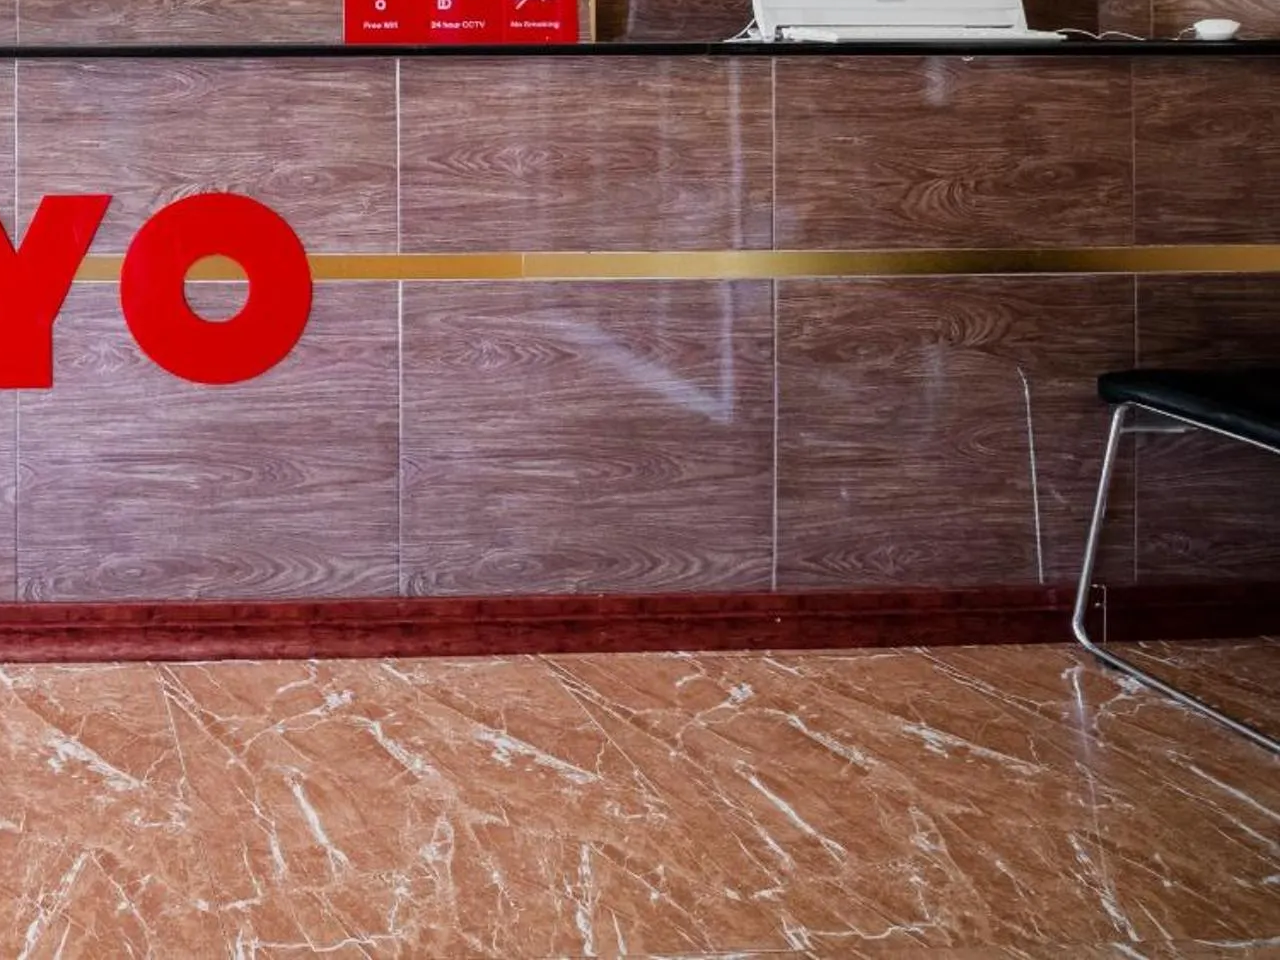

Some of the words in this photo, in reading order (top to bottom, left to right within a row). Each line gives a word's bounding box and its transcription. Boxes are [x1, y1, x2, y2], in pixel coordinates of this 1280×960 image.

[362, 20, 381, 30] Free
[431, 20, 441, 30] 24
[462, 20, 486, 30] CCTV
